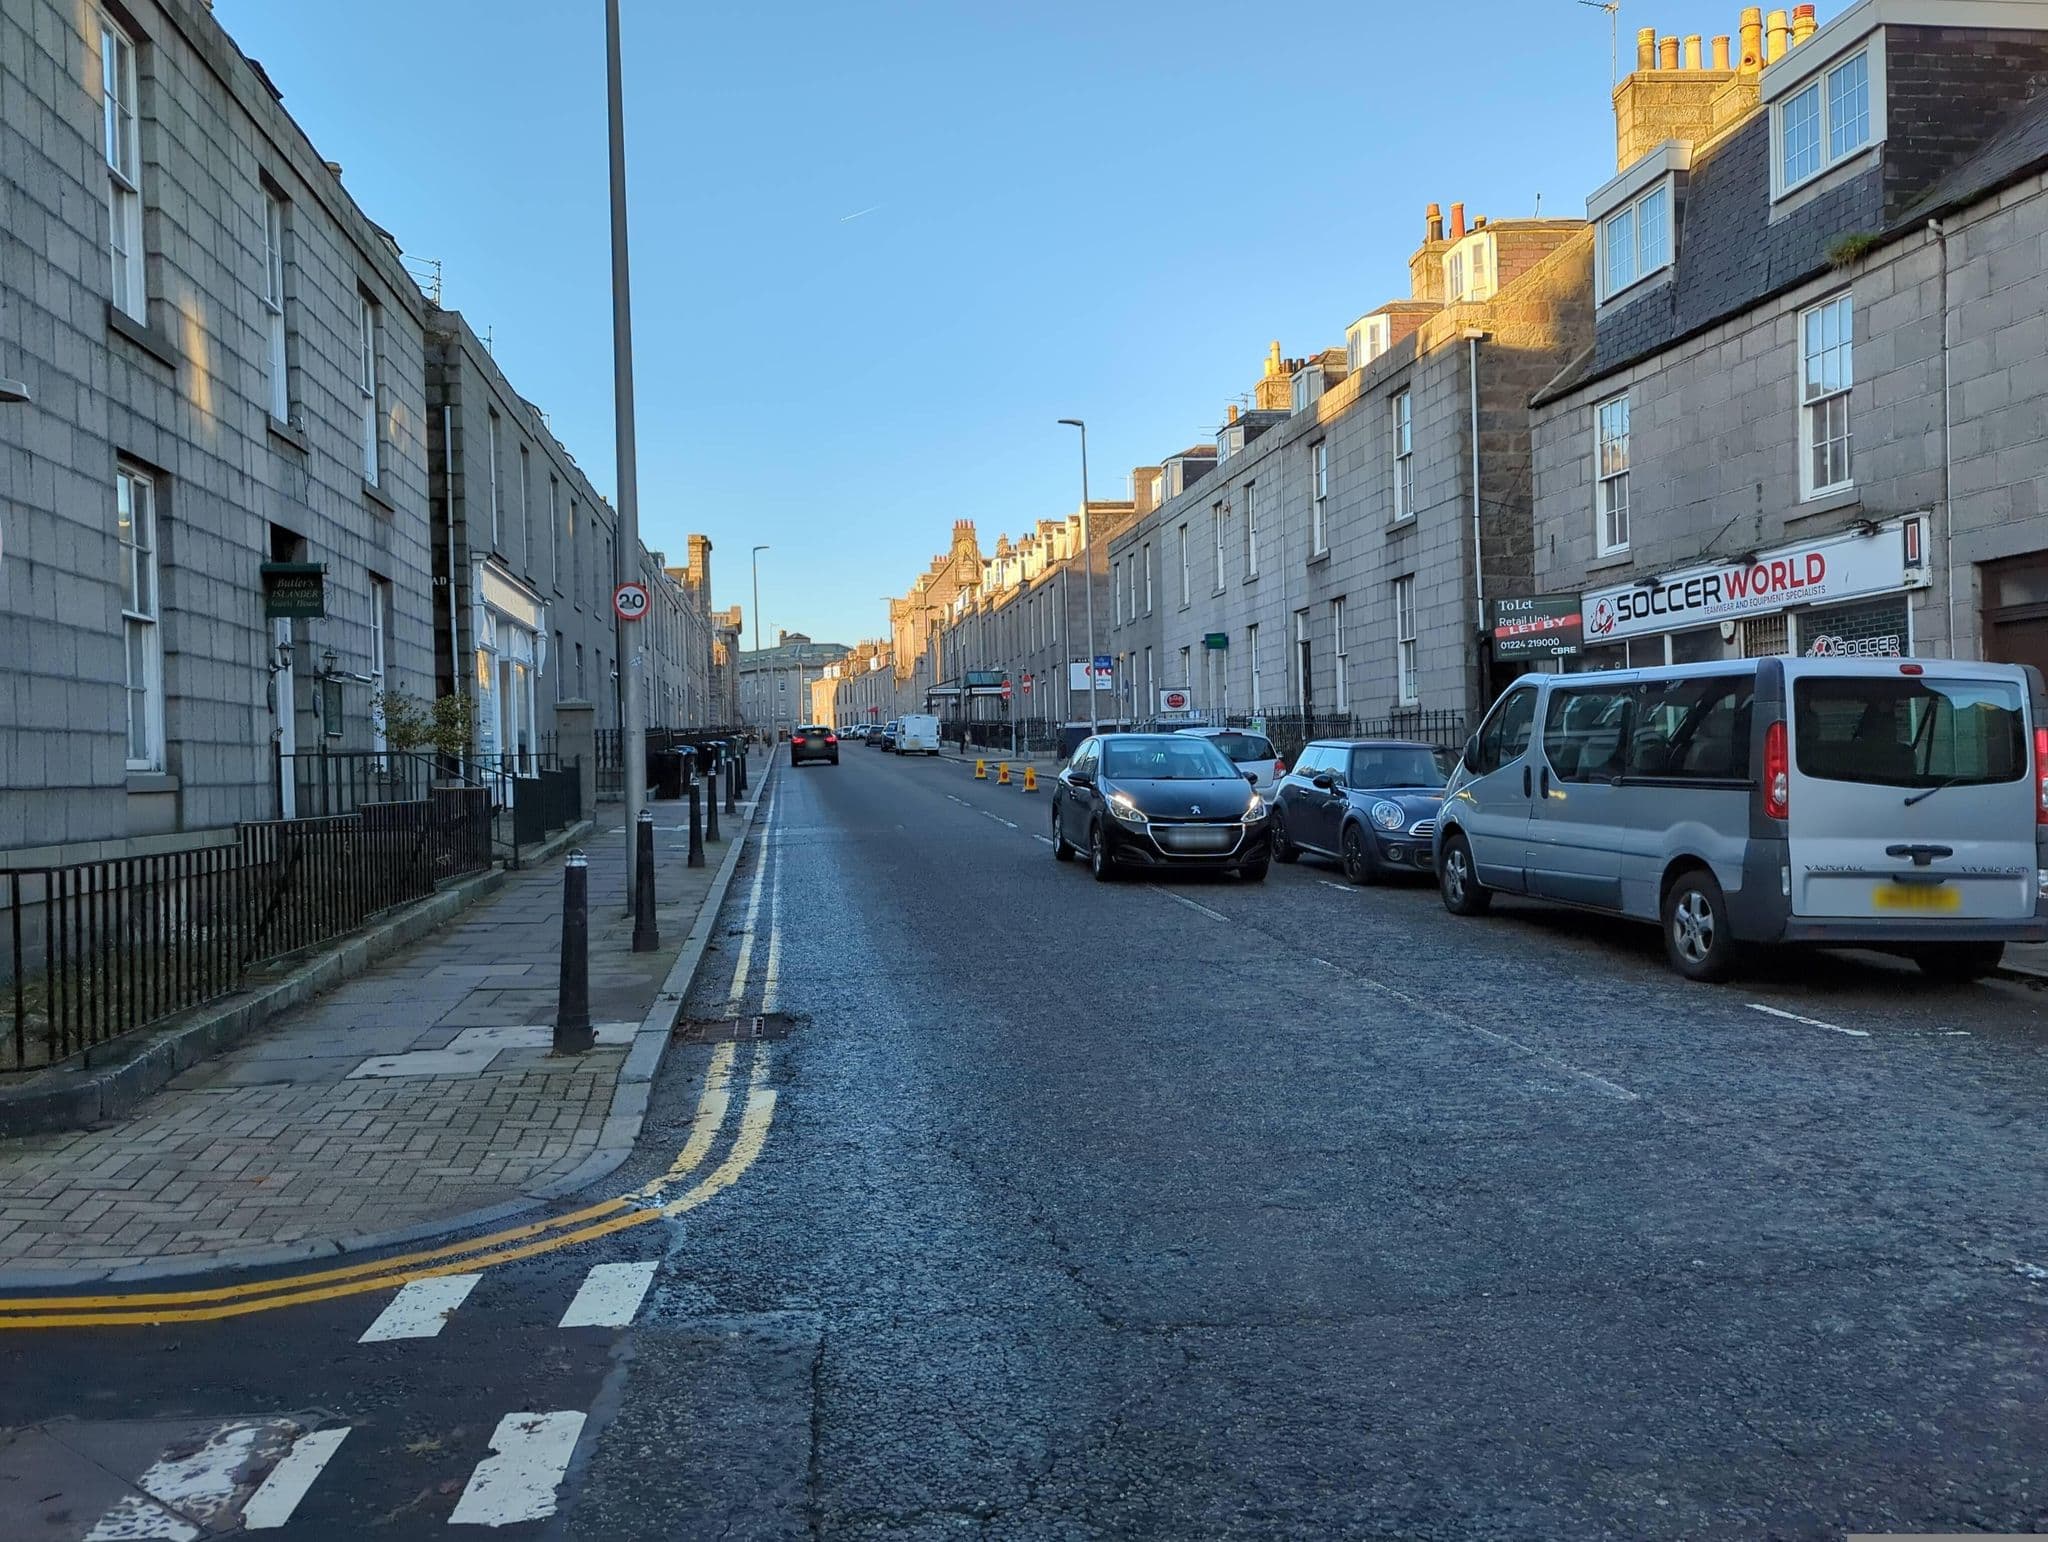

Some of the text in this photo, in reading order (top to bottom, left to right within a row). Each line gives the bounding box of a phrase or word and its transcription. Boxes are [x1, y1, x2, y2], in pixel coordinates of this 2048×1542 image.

[619, 593, 645, 609] 20
[1736, 600, 1748, 609] AND
[1749, 593, 1785, 607] EQUIPMENT
[1786, 585, 1826, 601] SPECIALISTS
[296, 600, 320, 608] House
[1498, 599, 1534, 611] To Let
[1499, 614, 1550, 627] Retail Unit
[1509, 617, 1567, 635] LET BY
[1500, 637, 1560, 650] 01224 219000
[1837, 635, 1899, 656] SOCCER
[1550, 646, 1577, 655] CBRE
